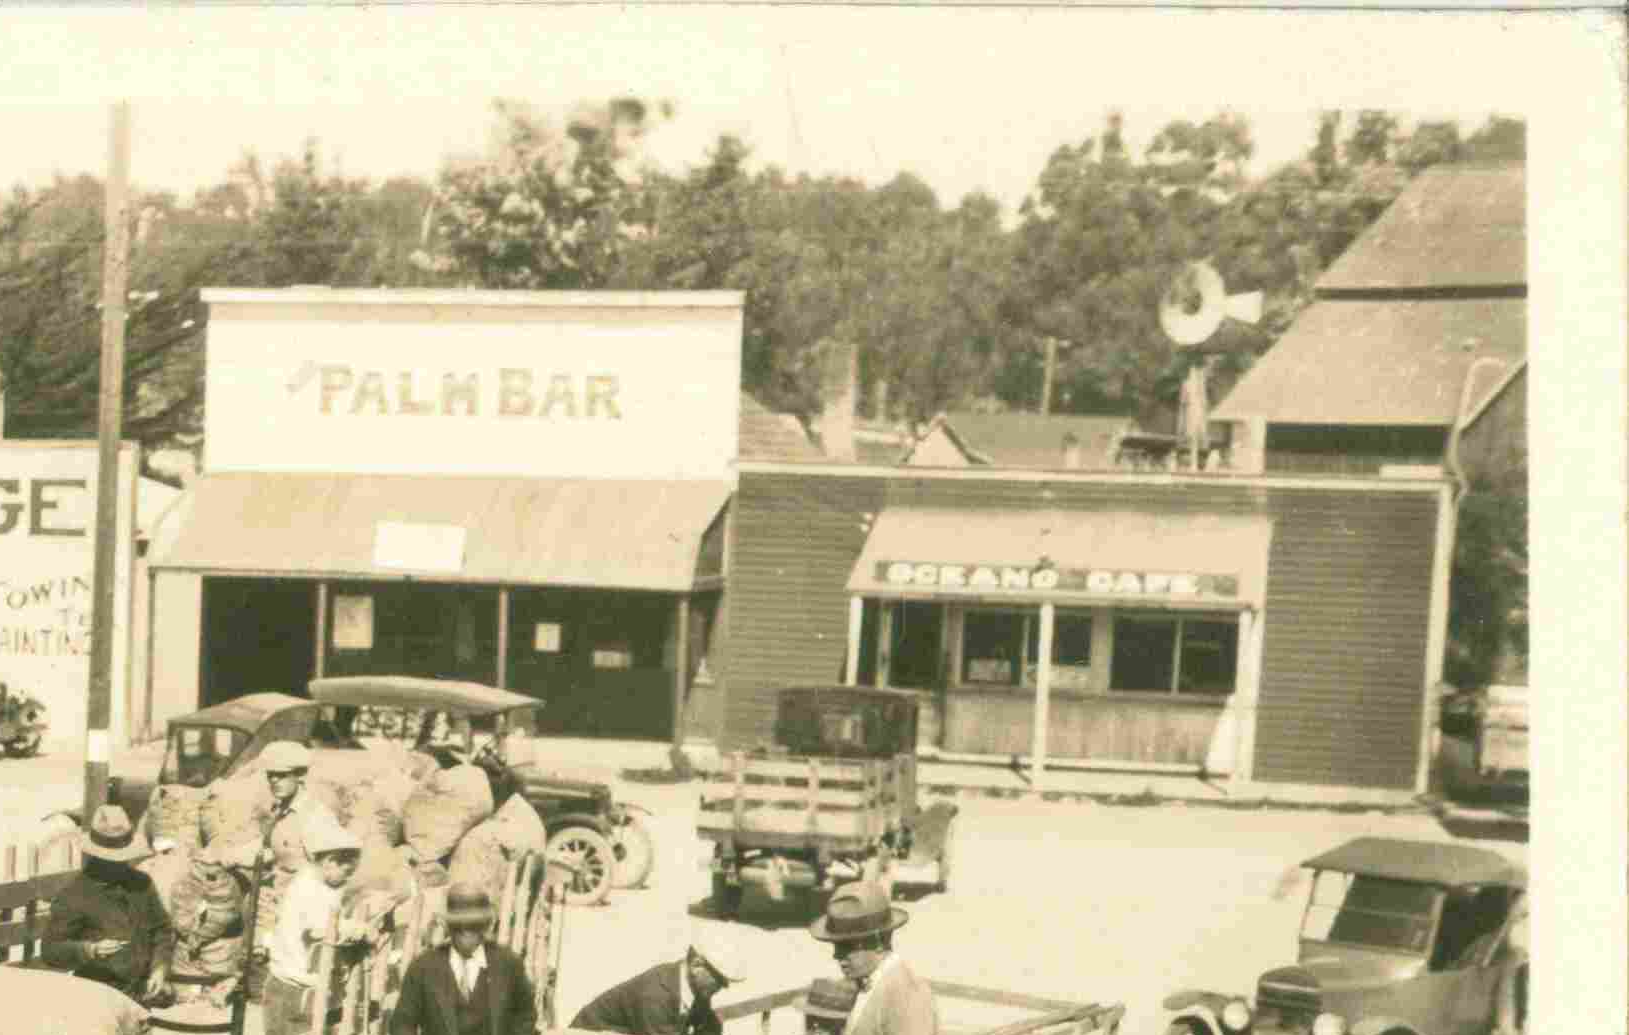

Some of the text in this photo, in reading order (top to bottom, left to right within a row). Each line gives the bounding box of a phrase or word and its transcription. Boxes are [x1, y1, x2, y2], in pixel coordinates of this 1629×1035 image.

[318, 364, 623, 420] PALM BAR
[885, 561, 1060, 591] OCEANO
